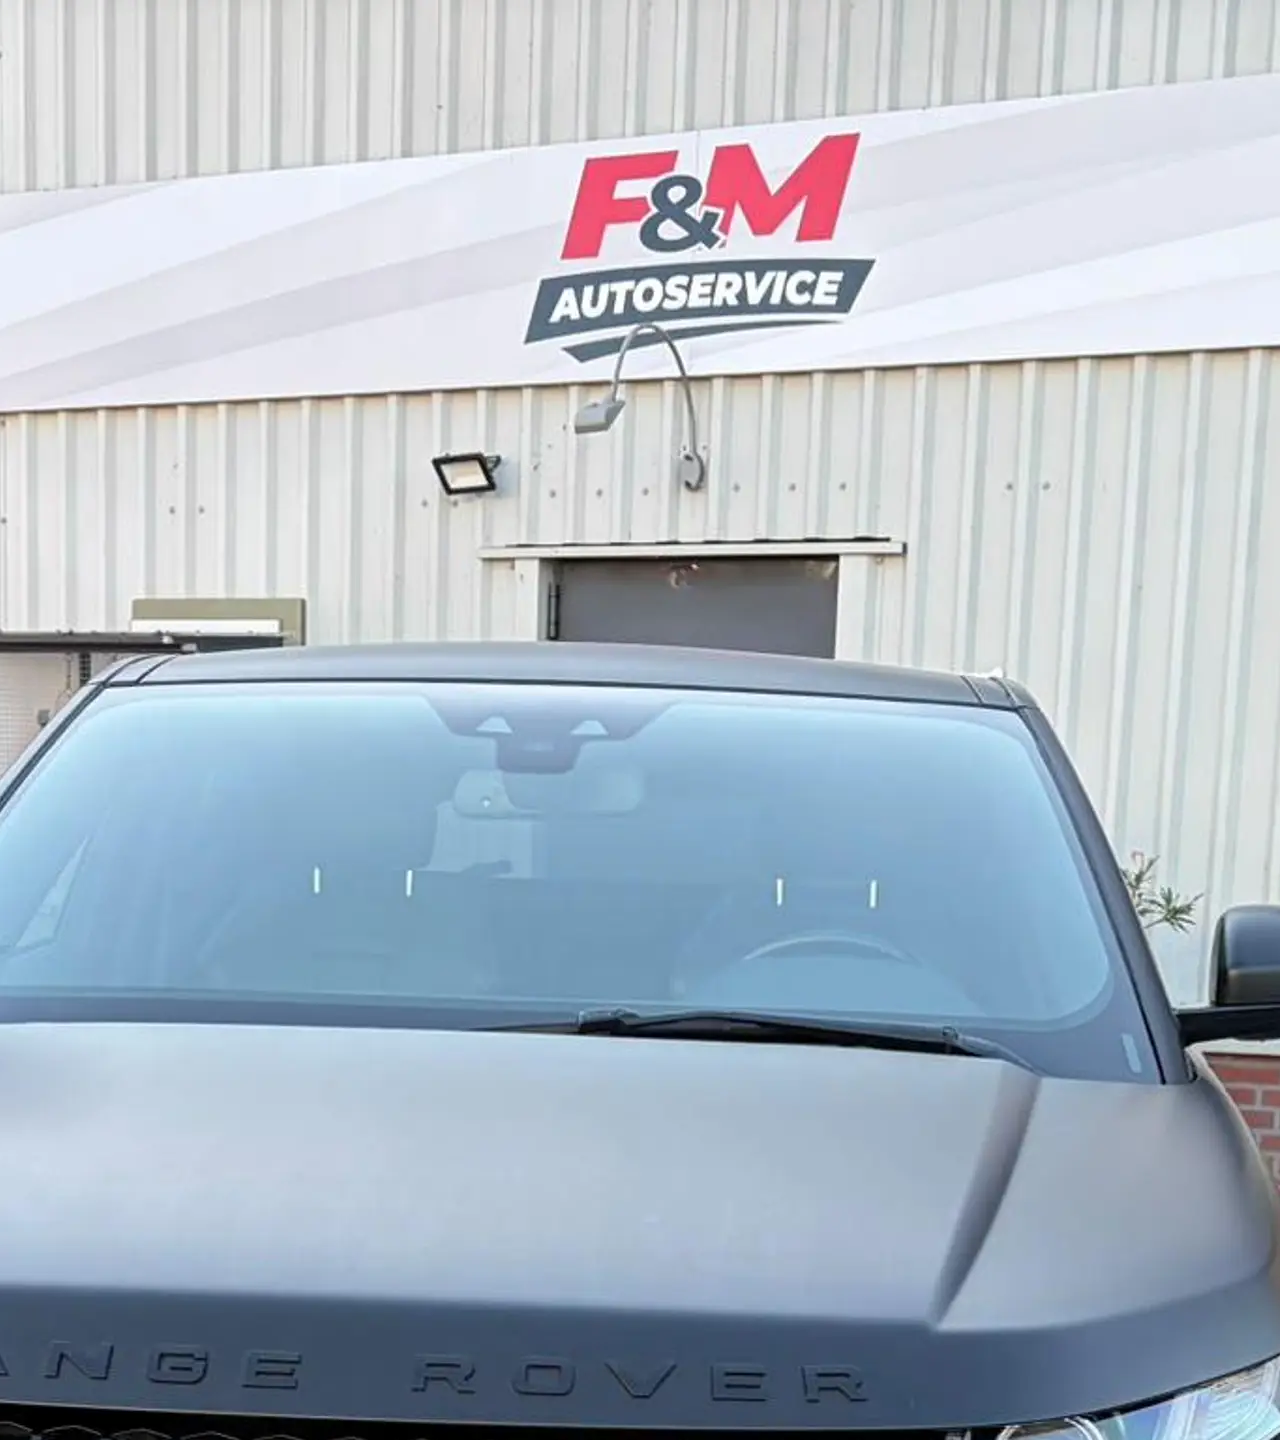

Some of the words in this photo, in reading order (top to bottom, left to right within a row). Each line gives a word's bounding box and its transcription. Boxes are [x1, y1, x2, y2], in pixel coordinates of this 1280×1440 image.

[561, 132, 861, 260] F&M
[549, 269, 845, 324] AUTOSERVICE
[411, 1354, 869, 1402] ROVER
